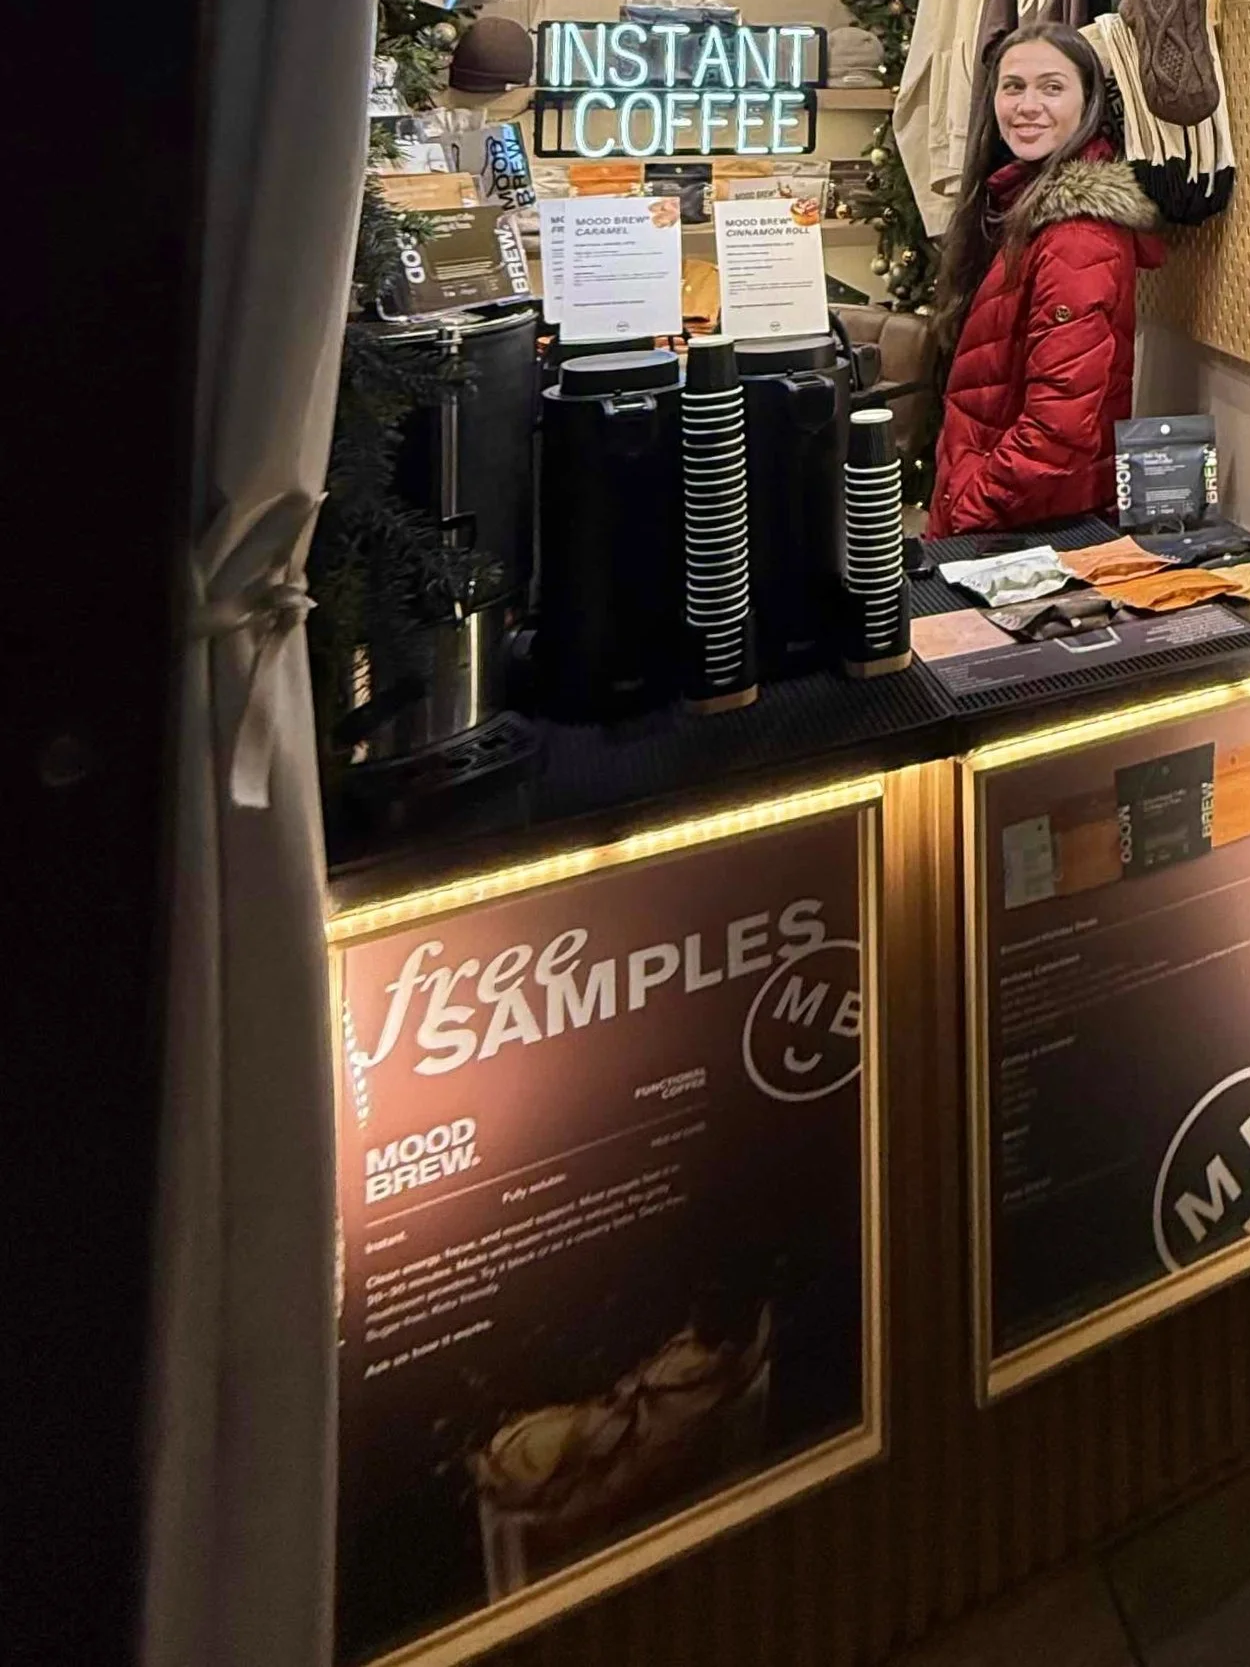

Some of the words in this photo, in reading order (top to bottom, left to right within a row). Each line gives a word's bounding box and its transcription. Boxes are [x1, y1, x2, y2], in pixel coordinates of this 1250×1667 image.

[550, 22, 816, 88] INSTANT
[575, 92, 806, 158] COFFEE
[574, 227, 629, 237] CARAMEL
[575, 217, 612, 226] MOOD
[725, 218, 758, 227] MOOD
[725, 228, 784, 238] CINNAMON
[785, 227, 810, 235] ROLL
[1115, 453, 1132, 511] MOOD
[358, 928, 589, 1068] free
[413, 899, 826, 1076] SAMPLES
[365, 1117, 476, 1176] MOOD
